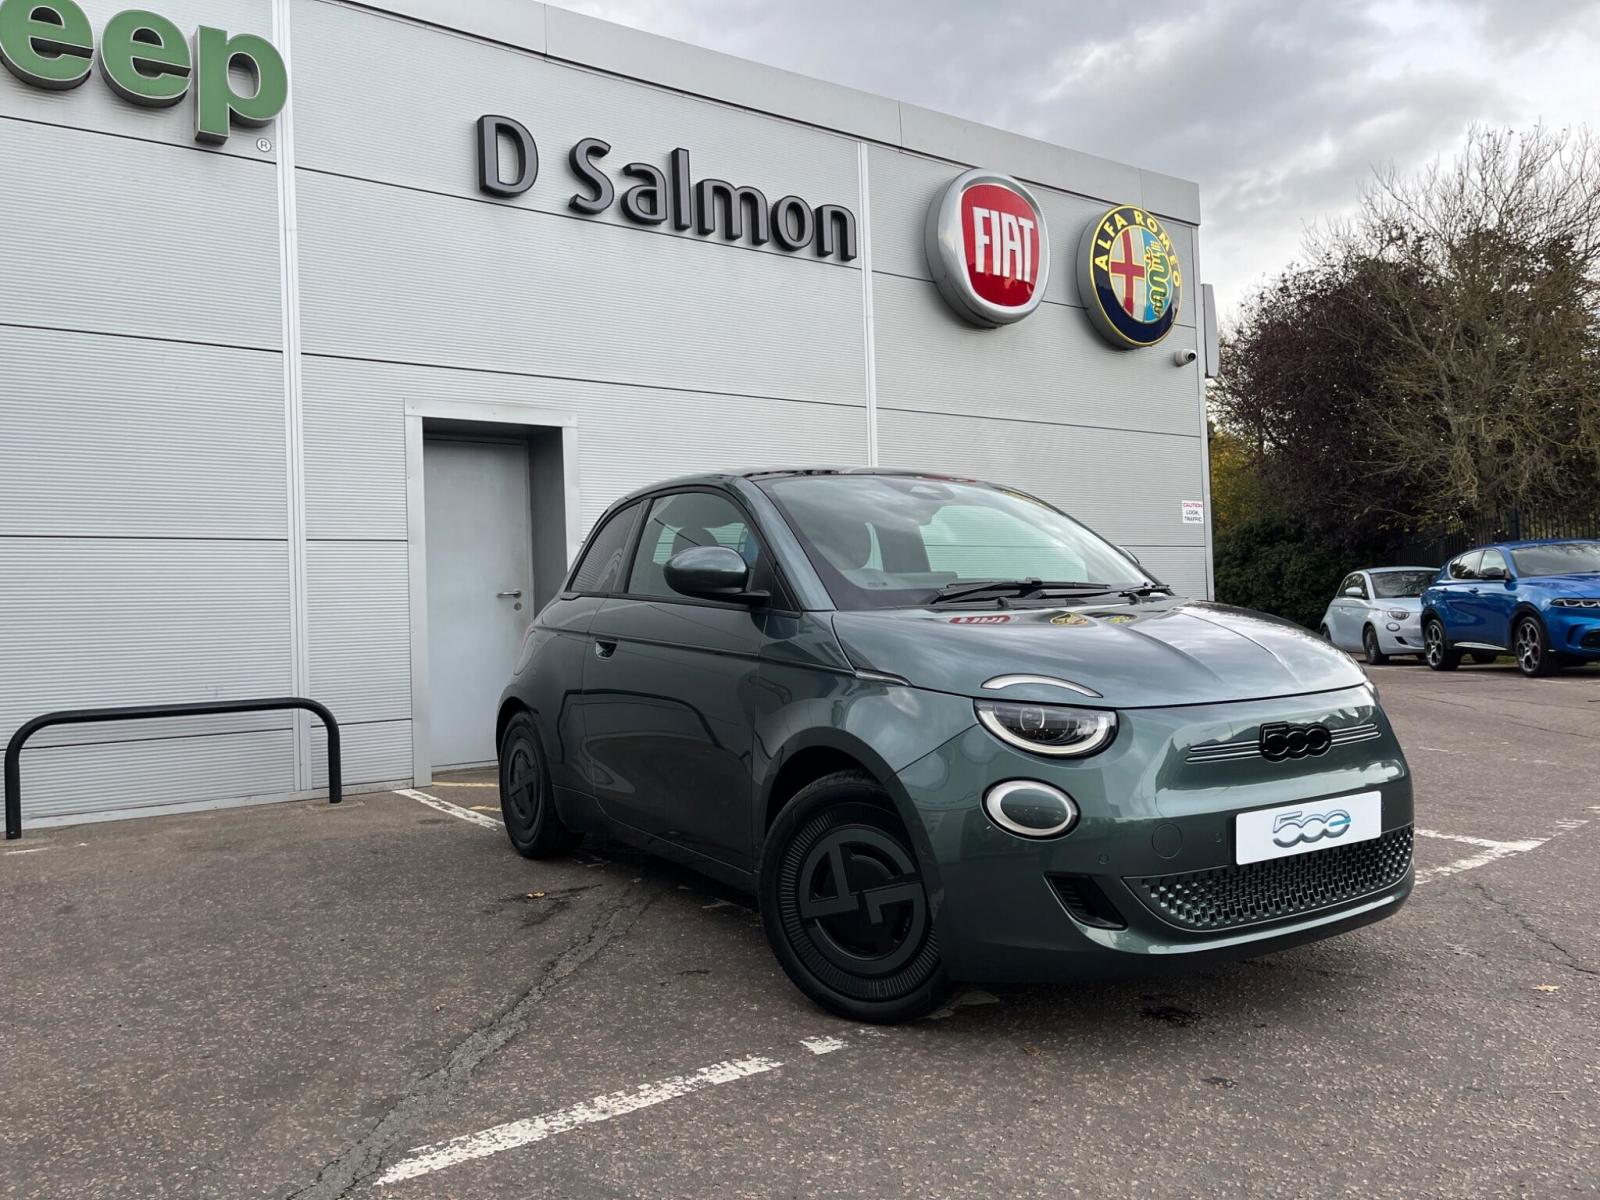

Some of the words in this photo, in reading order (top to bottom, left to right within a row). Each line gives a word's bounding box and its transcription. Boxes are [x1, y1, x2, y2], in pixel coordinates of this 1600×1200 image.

[476, 114, 539, 198] D
[568, 137, 857, 262] Salmon
[972, 206, 1034, 282] FIAT
[1095, 212, 1128, 271] ALFA
[1135, 210, 1180, 288] ROMEO
[1259, 721, 1332, 763] 500
